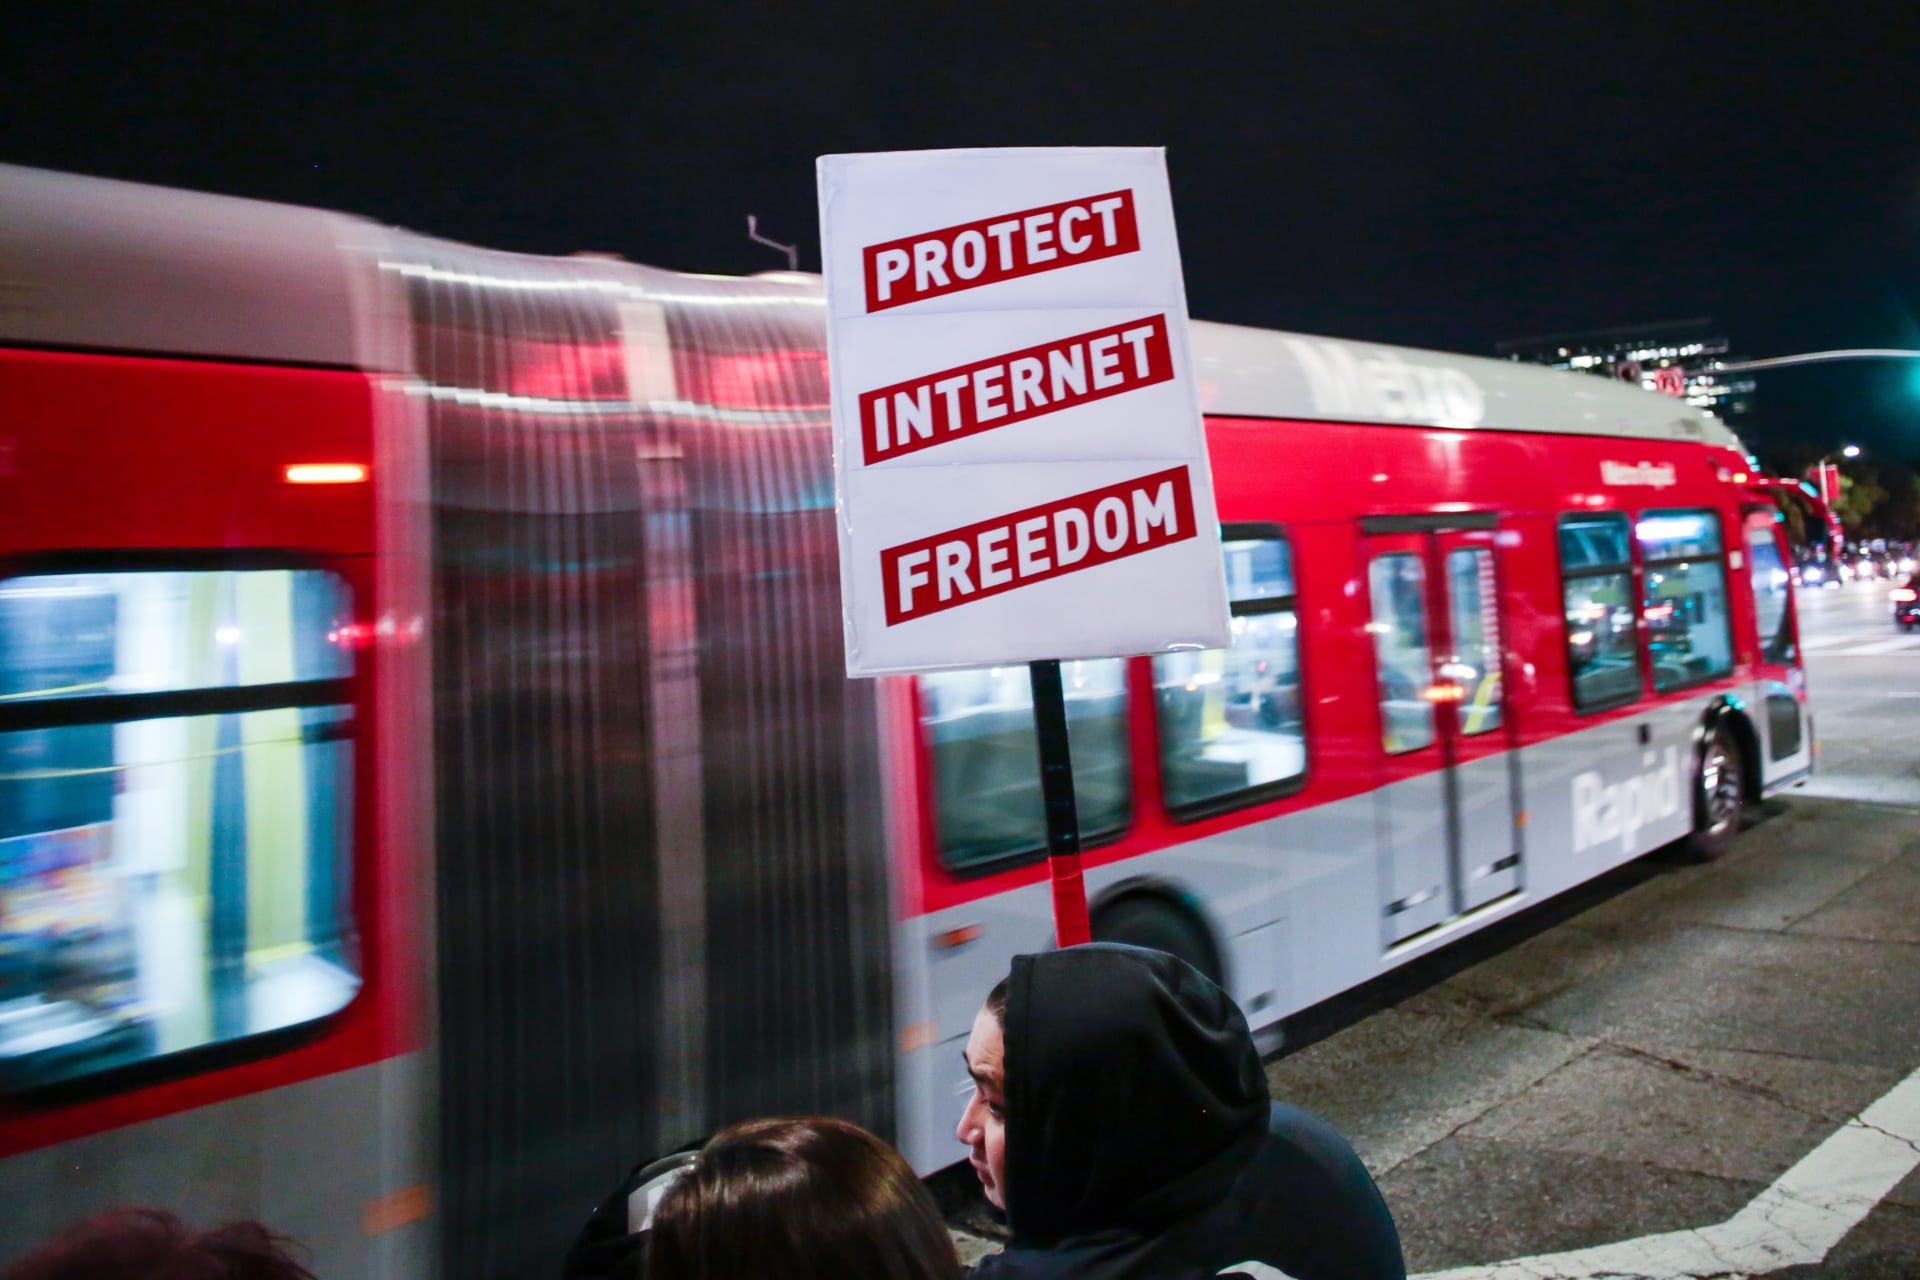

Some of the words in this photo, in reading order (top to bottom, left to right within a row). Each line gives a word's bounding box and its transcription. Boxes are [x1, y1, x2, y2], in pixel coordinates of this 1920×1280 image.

[876, 197, 1123, 302] PROTECT
[873, 325, 1154, 452] INTERNET
[897, 481, 1178, 613] FREEDOM
[1572, 746, 1679, 853] Rapid
